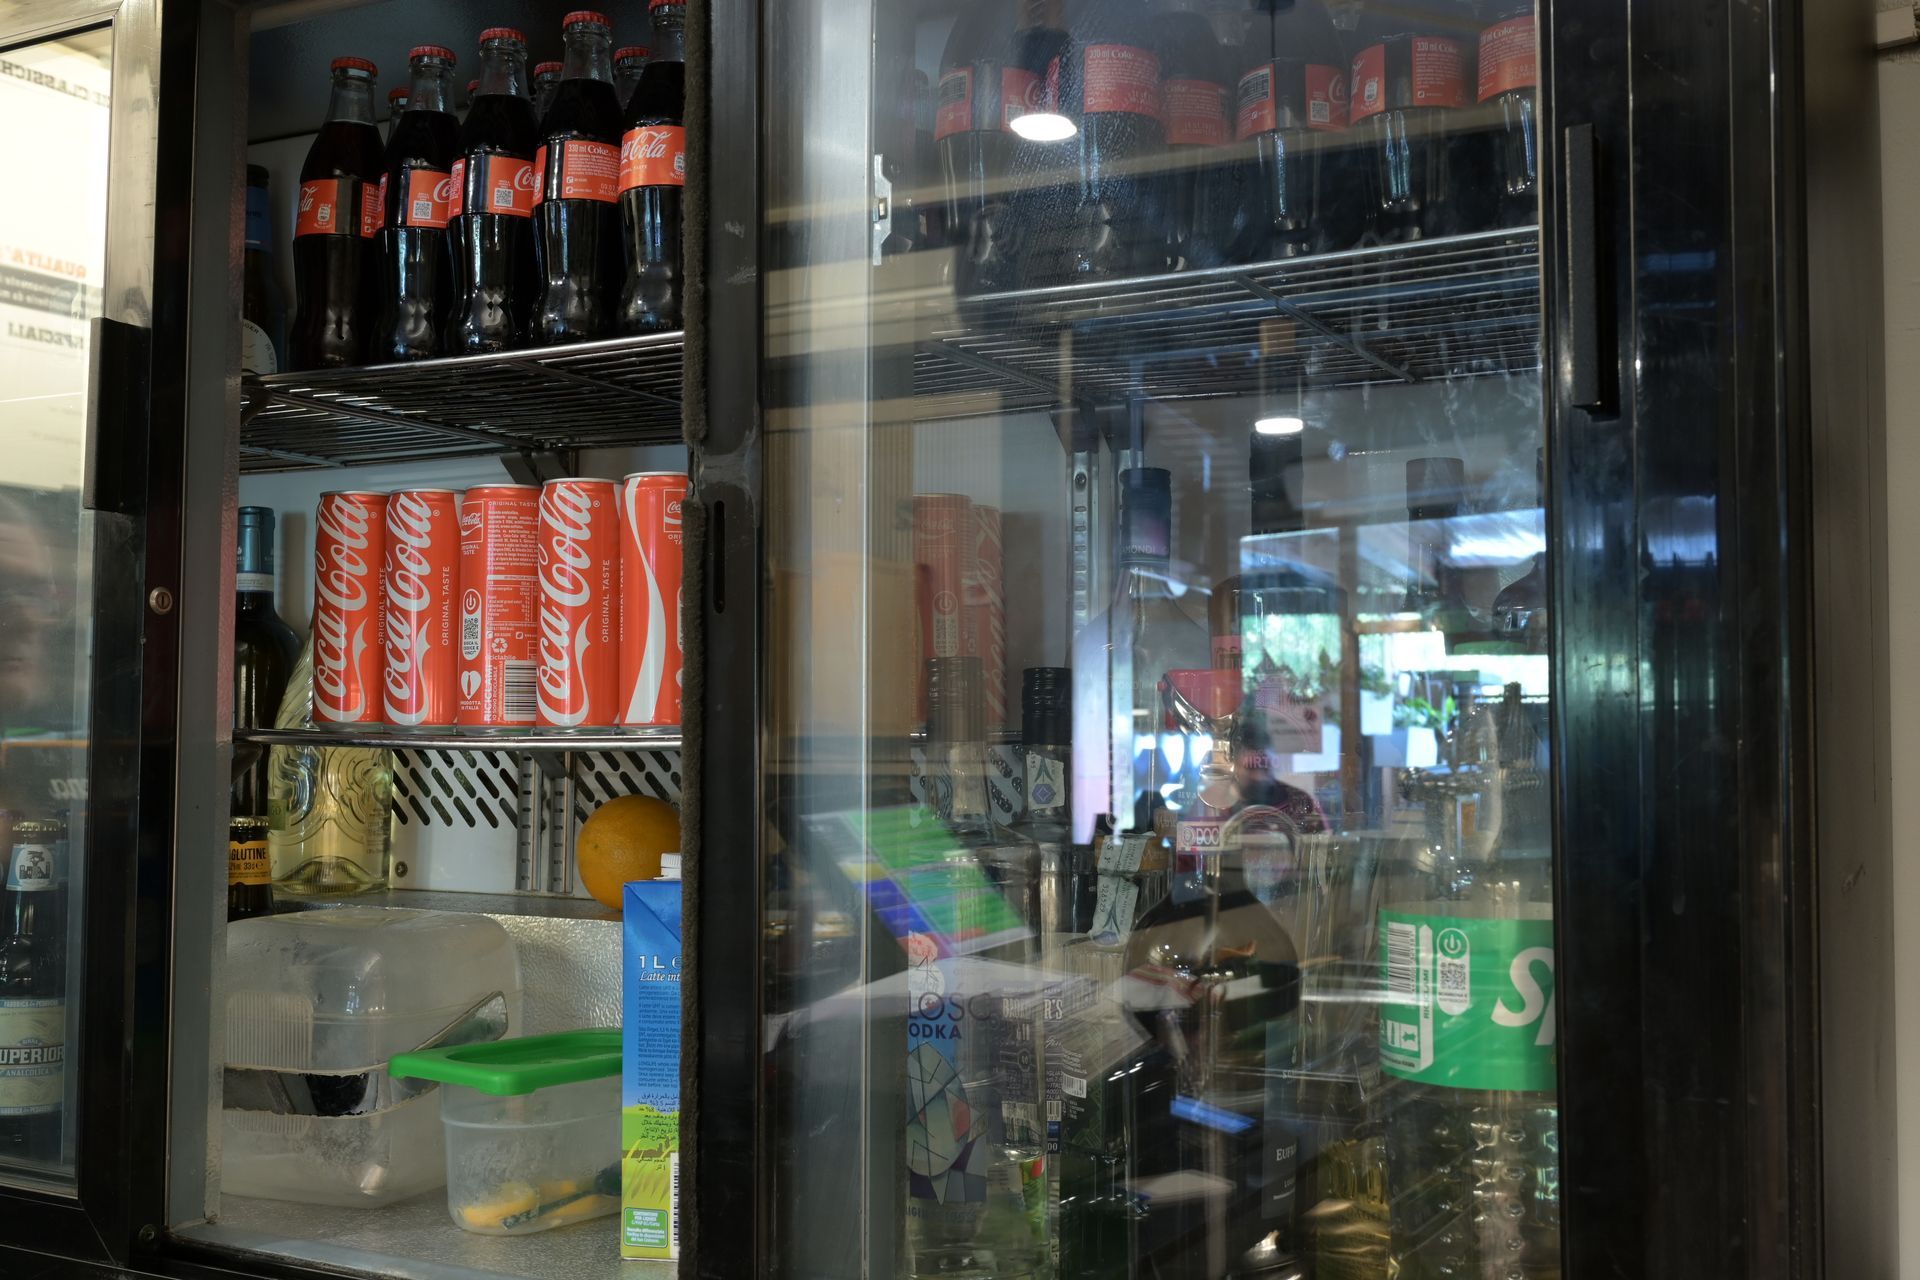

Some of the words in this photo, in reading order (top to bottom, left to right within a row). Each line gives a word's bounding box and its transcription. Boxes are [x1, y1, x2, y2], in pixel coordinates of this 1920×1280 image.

[587, 144, 609, 155] Coke
[378, 567, 386, 597] TASTE
[442, 566, 450, 597] TASTE
[313, 494, 369, 723] Coca-Cola
[384, 492, 432, 726] Coca-Cola
[536, 484, 592, 726] Coca-Cola
[378, 600, 386, 645] ORIGINAL
[441, 599, 449, 646] ORIGINAL
[602, 598, 610, 643] ORIGINAL
[1196, 827, 1219, 846] DOC
[231, 848, 266, 861] GLUTINE
[639, 955, 646, 968] 1
[653, 955, 665, 968] L
[640, 970, 665, 981] Latte
[909, 1022, 962, 1040] ODKA
[0, 1045, 64, 1064] UPERIOR
